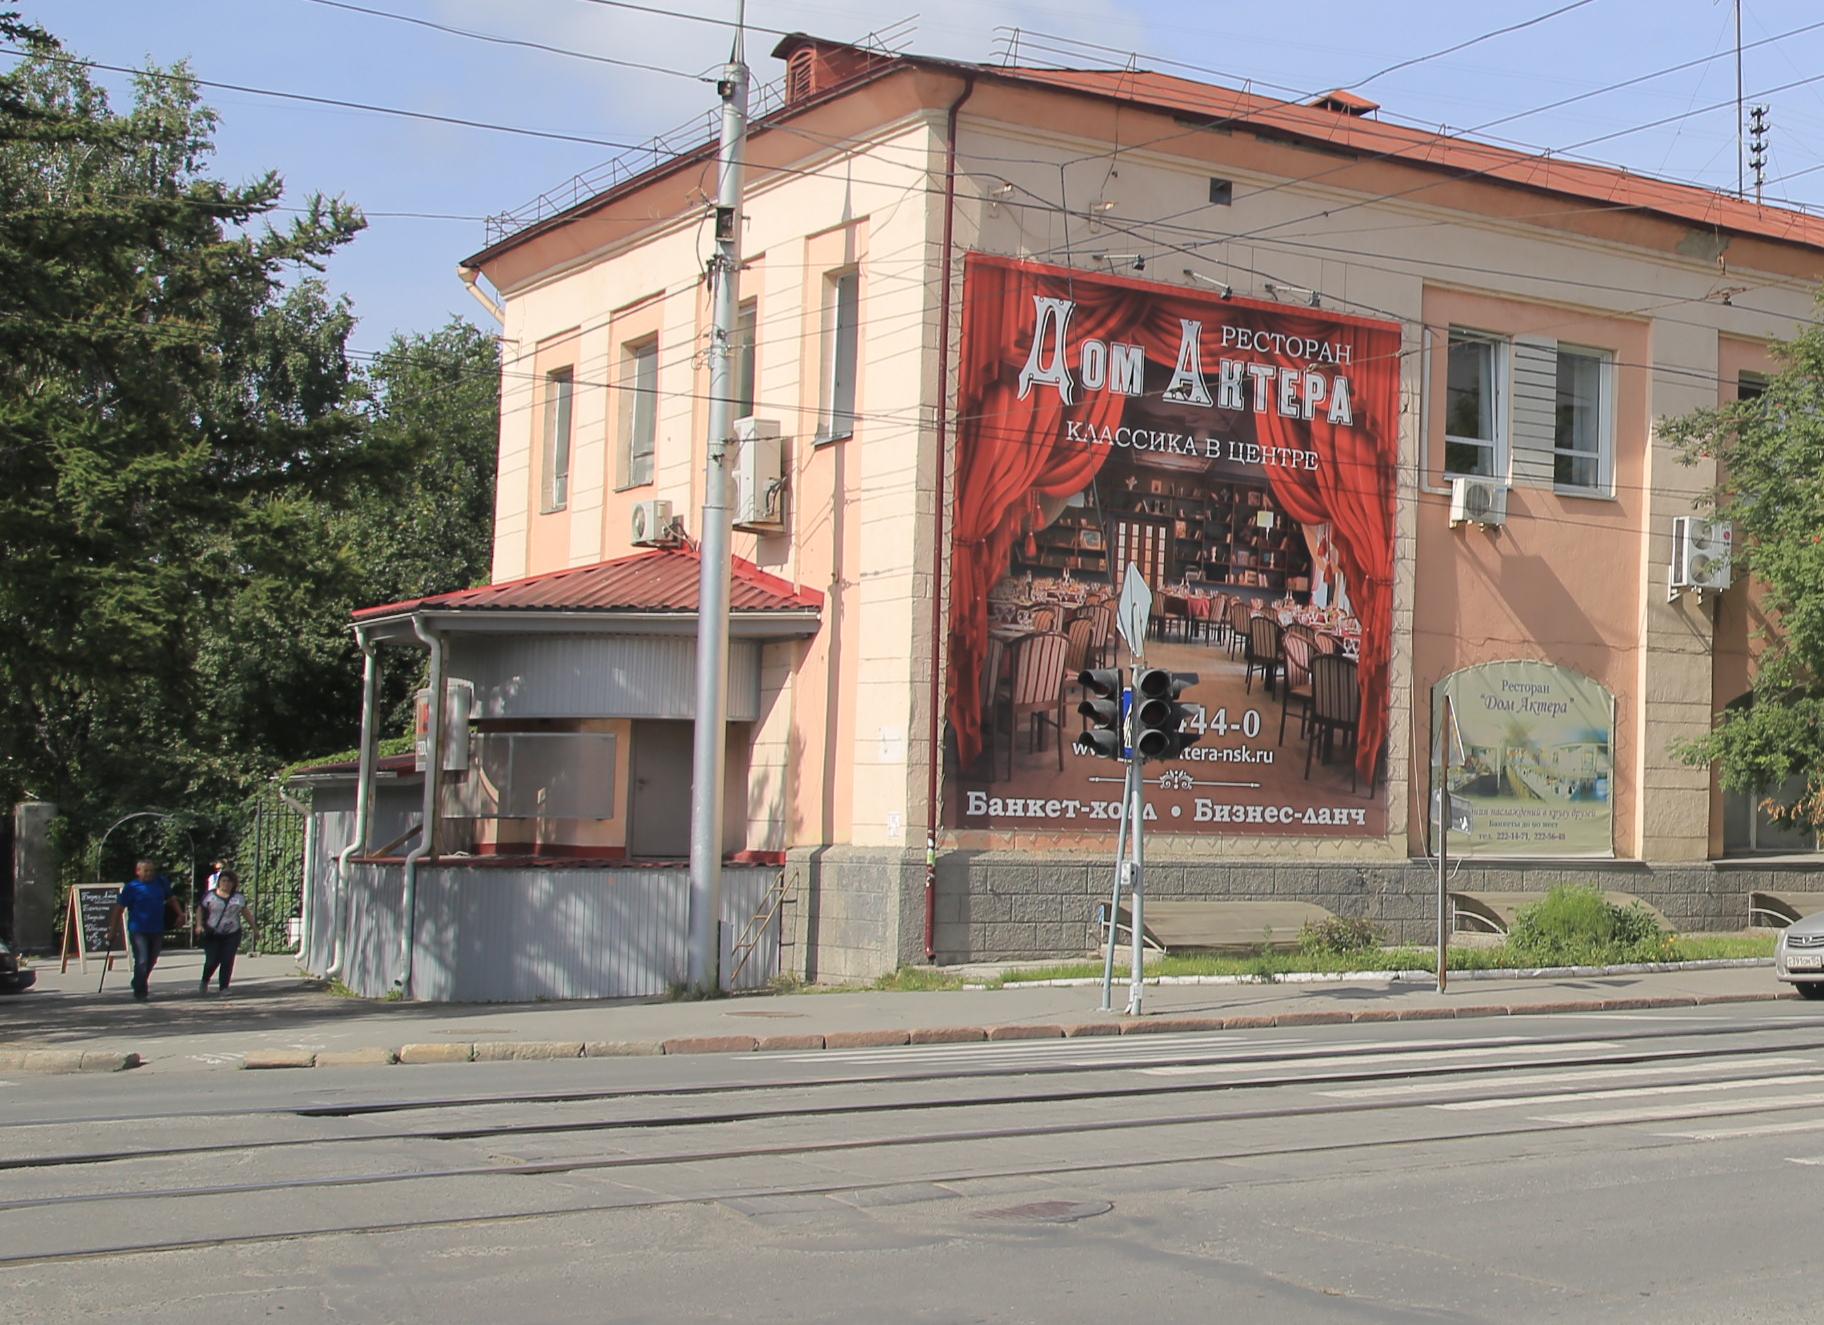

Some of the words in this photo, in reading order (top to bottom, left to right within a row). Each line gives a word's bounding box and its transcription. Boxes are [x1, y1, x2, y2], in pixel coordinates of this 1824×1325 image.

[1221, 326, 1351, 365] РЕСТОРАН
[1066, 420, 1198, 458] КЛАССИКА
[1205, 438, 1220, 459] В
[1228, 441, 1319, 471] ЦЕНТРЕ
[1502, 680, 1550, 696] Ресторан
[1193, 798, 1366, 825] Бизнес-ланч
